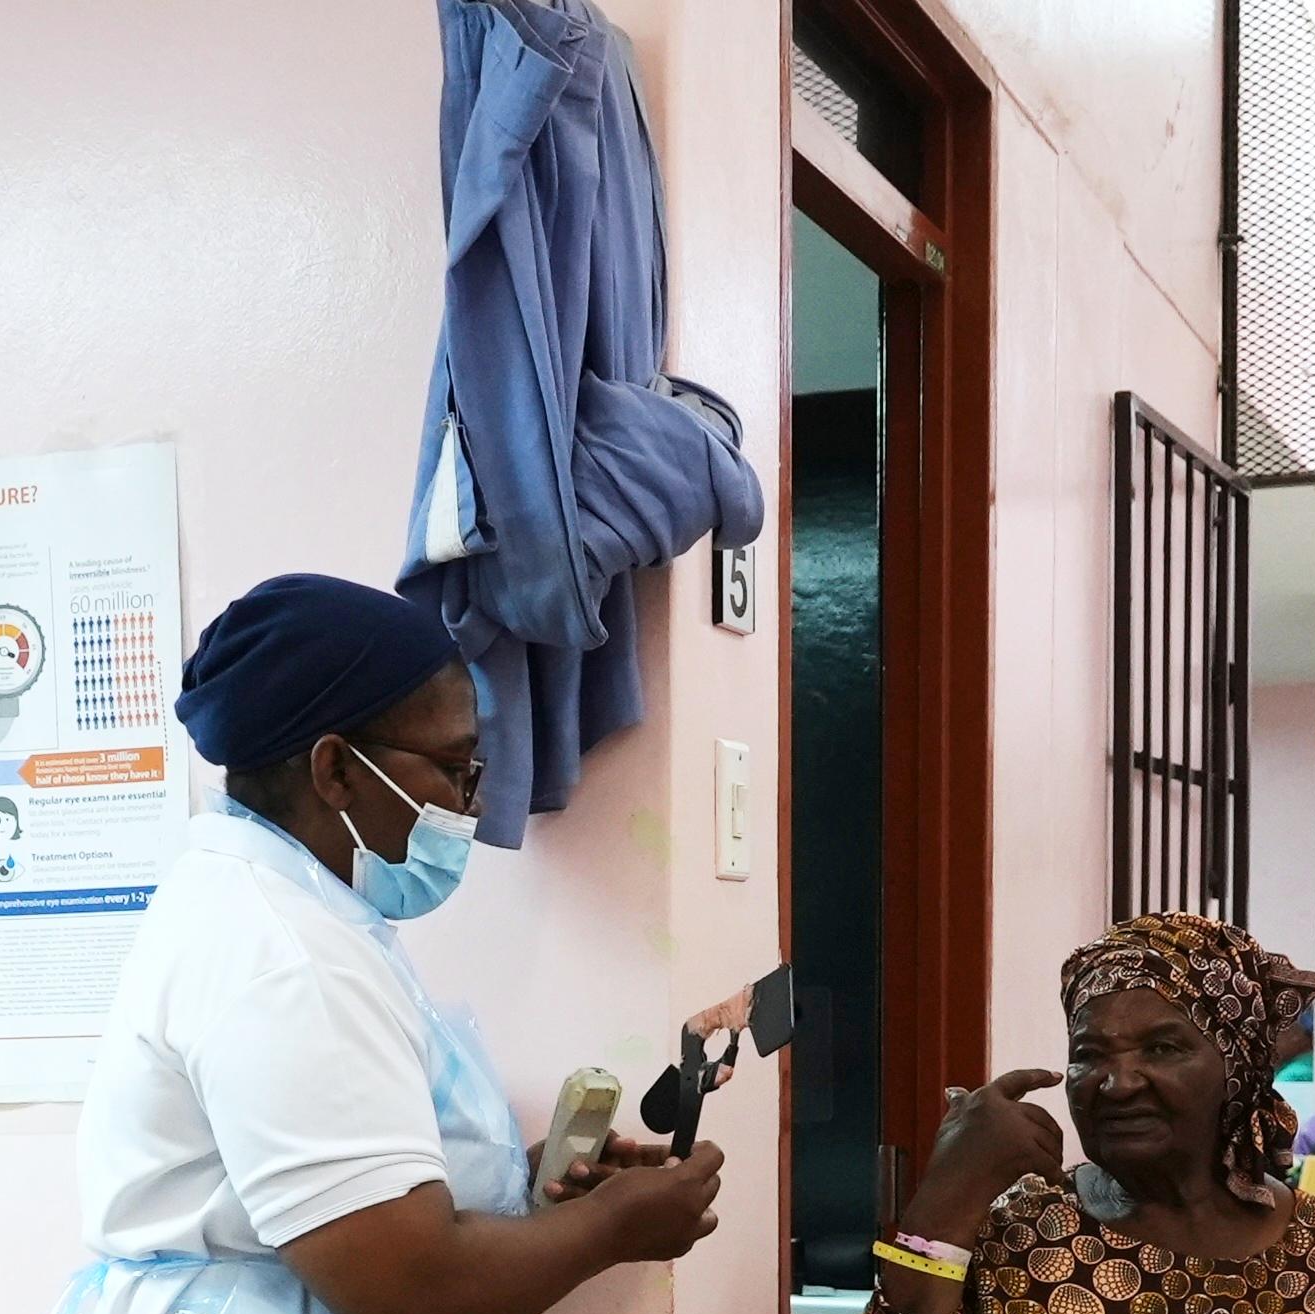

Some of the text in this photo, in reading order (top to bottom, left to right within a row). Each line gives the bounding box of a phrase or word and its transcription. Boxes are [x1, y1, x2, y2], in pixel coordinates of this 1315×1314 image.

[730, 549, 747, 618] 5
[70, 590, 154, 614] 60 million
[99, 753, 106, 763] 3
[107, 752, 141, 762] million
[36, 775, 52, 785] half
[53, 774, 62, 783] of
[62, 773, 85, 783] those
[86, 772, 109, 782] know
[110, 771, 129, 781] they
[130, 769, 150, 779] have
[29, 797, 62, 807] Regular
[82, 794, 110, 802] exams
[128, 789, 166, 800] essential
[32, 850, 114, 862] Treatment Options
[60, 895, 104, 905] examination
[104, 894, 130, 906] every
[131, 891, 144, 902] 1-2
